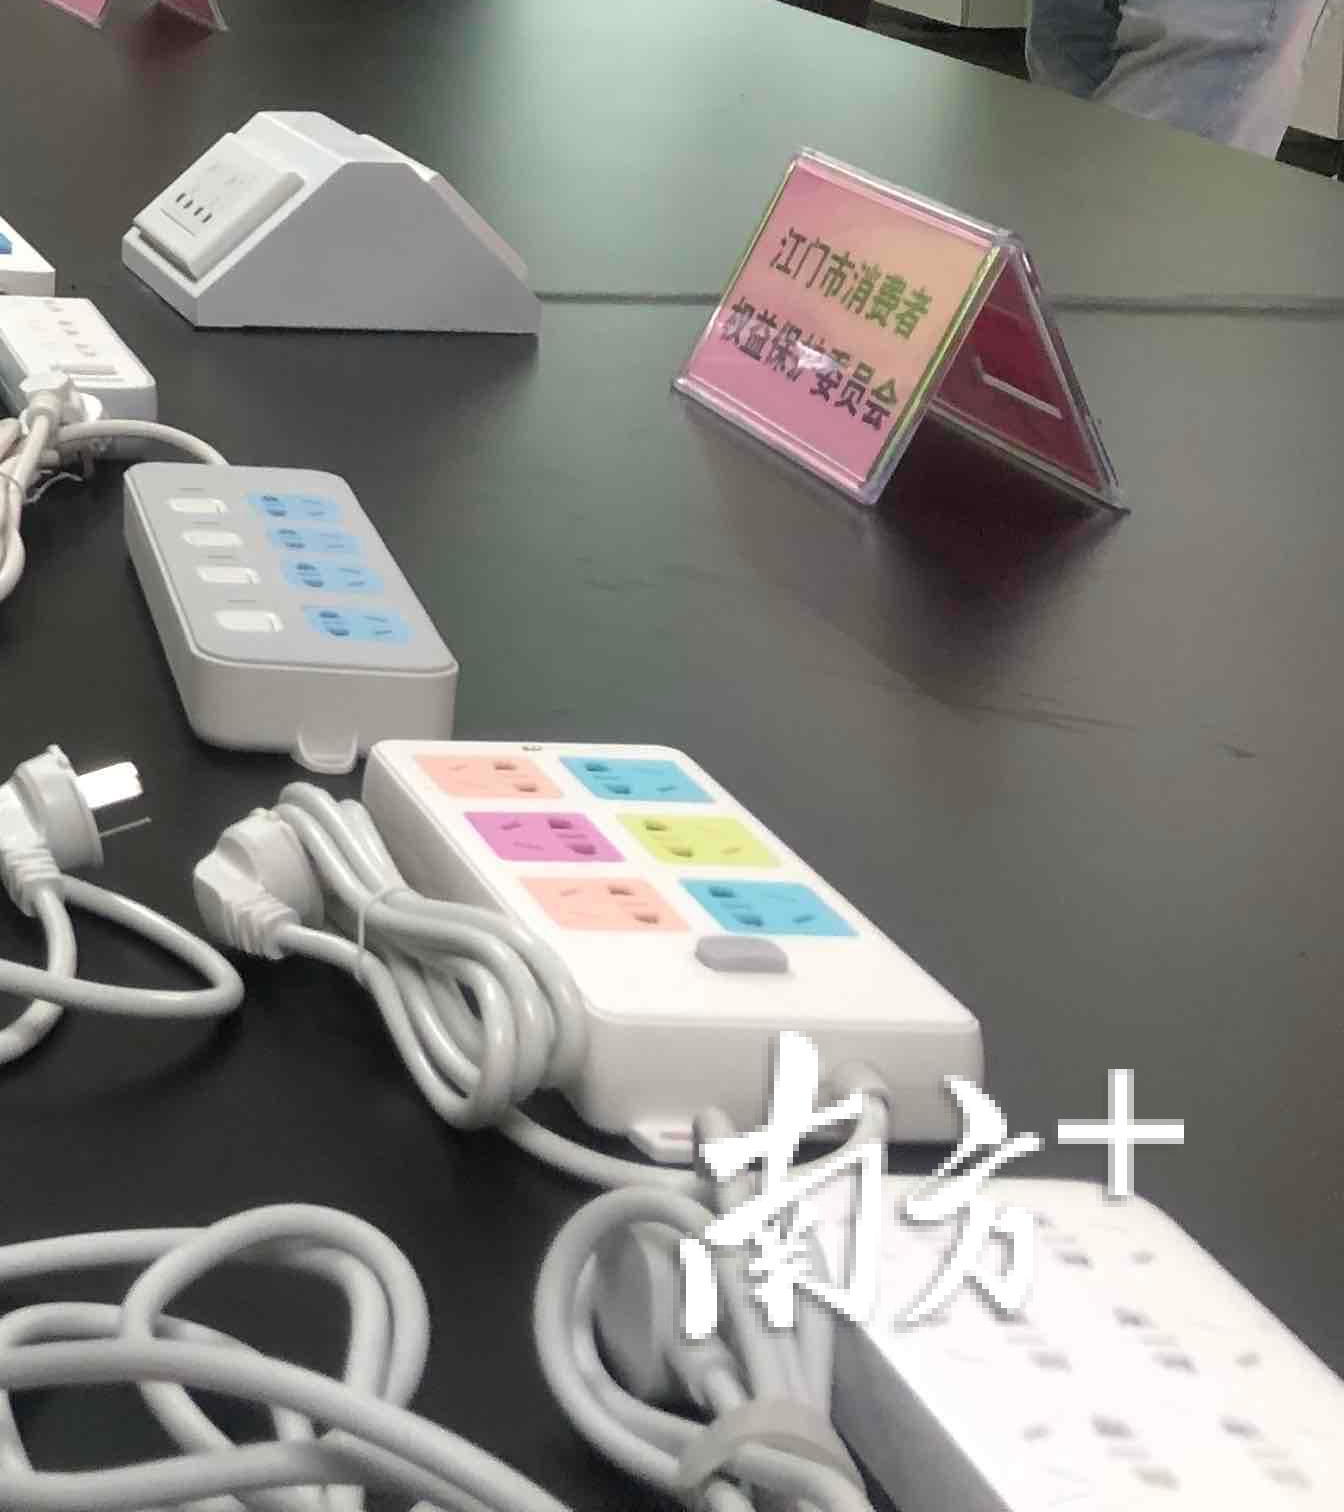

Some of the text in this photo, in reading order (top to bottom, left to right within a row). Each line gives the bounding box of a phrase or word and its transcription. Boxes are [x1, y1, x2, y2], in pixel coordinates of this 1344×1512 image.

[769, 226, 933, 340] 江门市消费者
